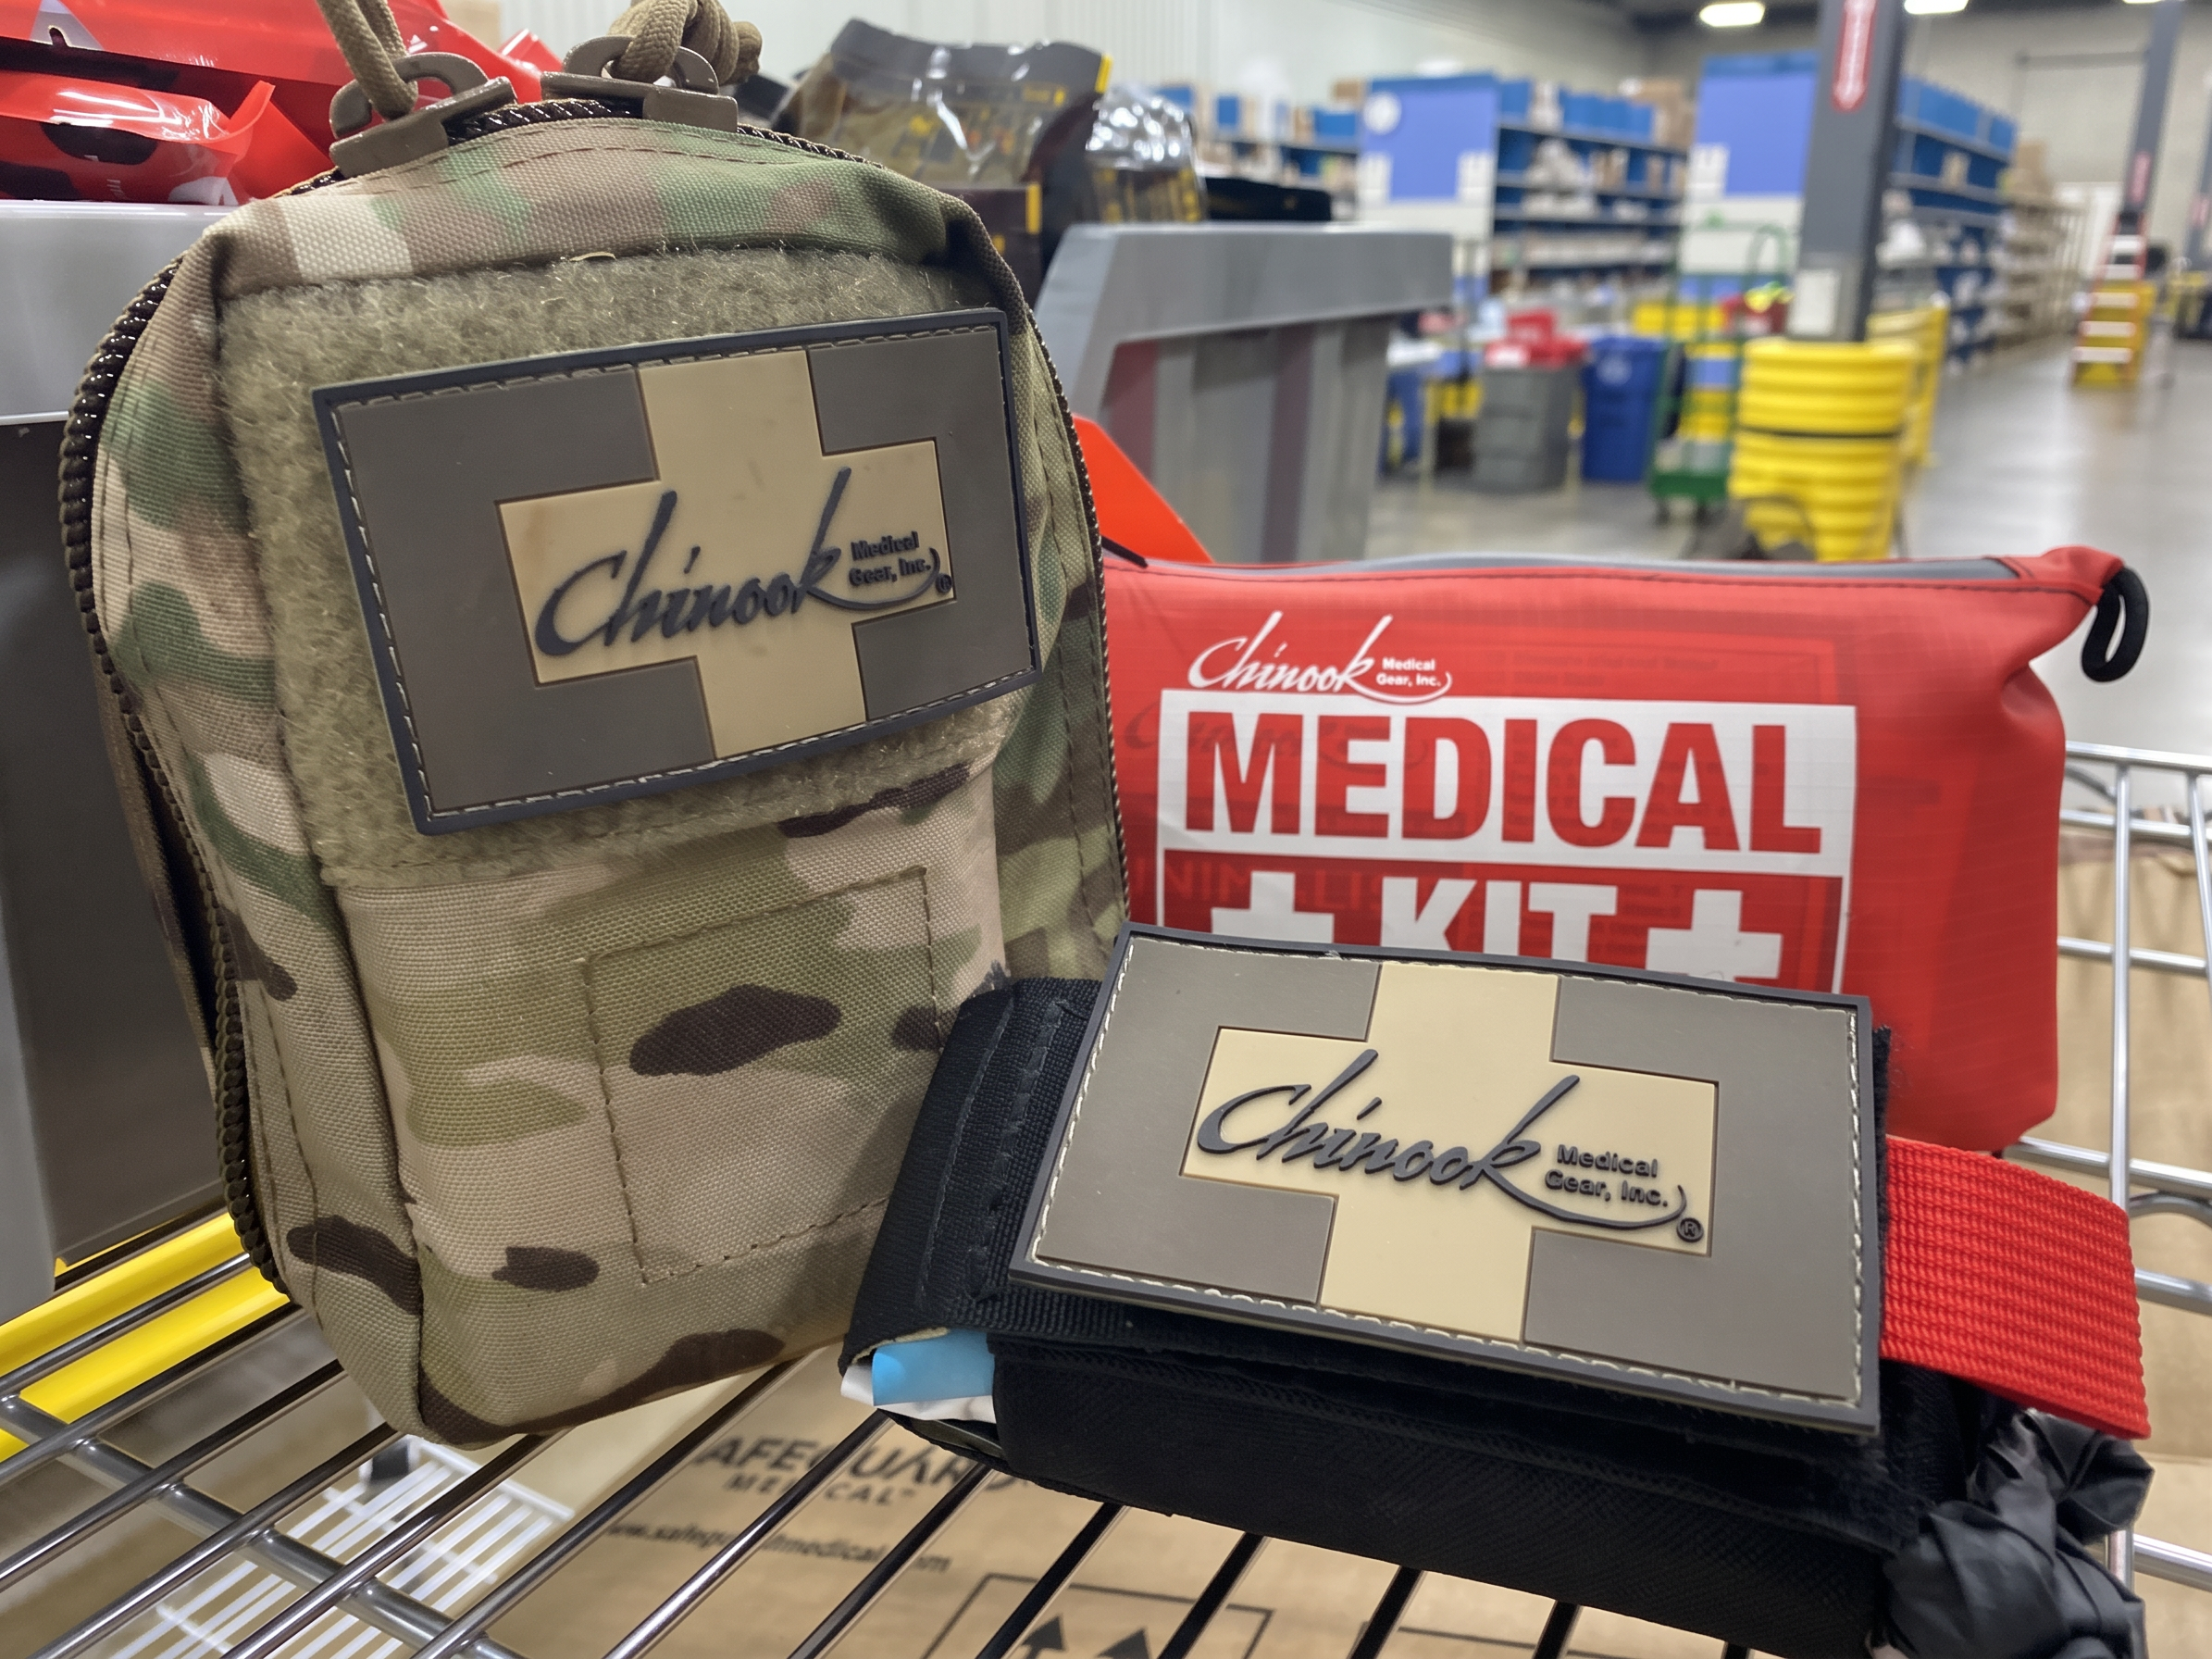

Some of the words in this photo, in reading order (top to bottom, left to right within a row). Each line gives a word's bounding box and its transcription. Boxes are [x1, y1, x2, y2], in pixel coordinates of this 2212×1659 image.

[535, 466, 852, 656] Chinook
[850, 530, 920, 561] Medical
[849, 565, 898, 587] Gear,
[898, 557, 932, 577] Inc.
[1187, 609, 1393, 692] Chinook
[1381, 656, 1436, 672] Medical
[1375, 672, 1412, 688] Gear,
[1415, 673, 1441, 687] Inc.
[1185, 710, 1822, 854] MEDICAL
[1379, 875, 1618, 967] KIT
[1197, 1048, 1580, 1191] Chinook
[1557, 1143, 1659, 1179] Medical
[1545, 1168, 1611, 1203] Gear,
[1621, 1179, 1669, 1207] Inc.
